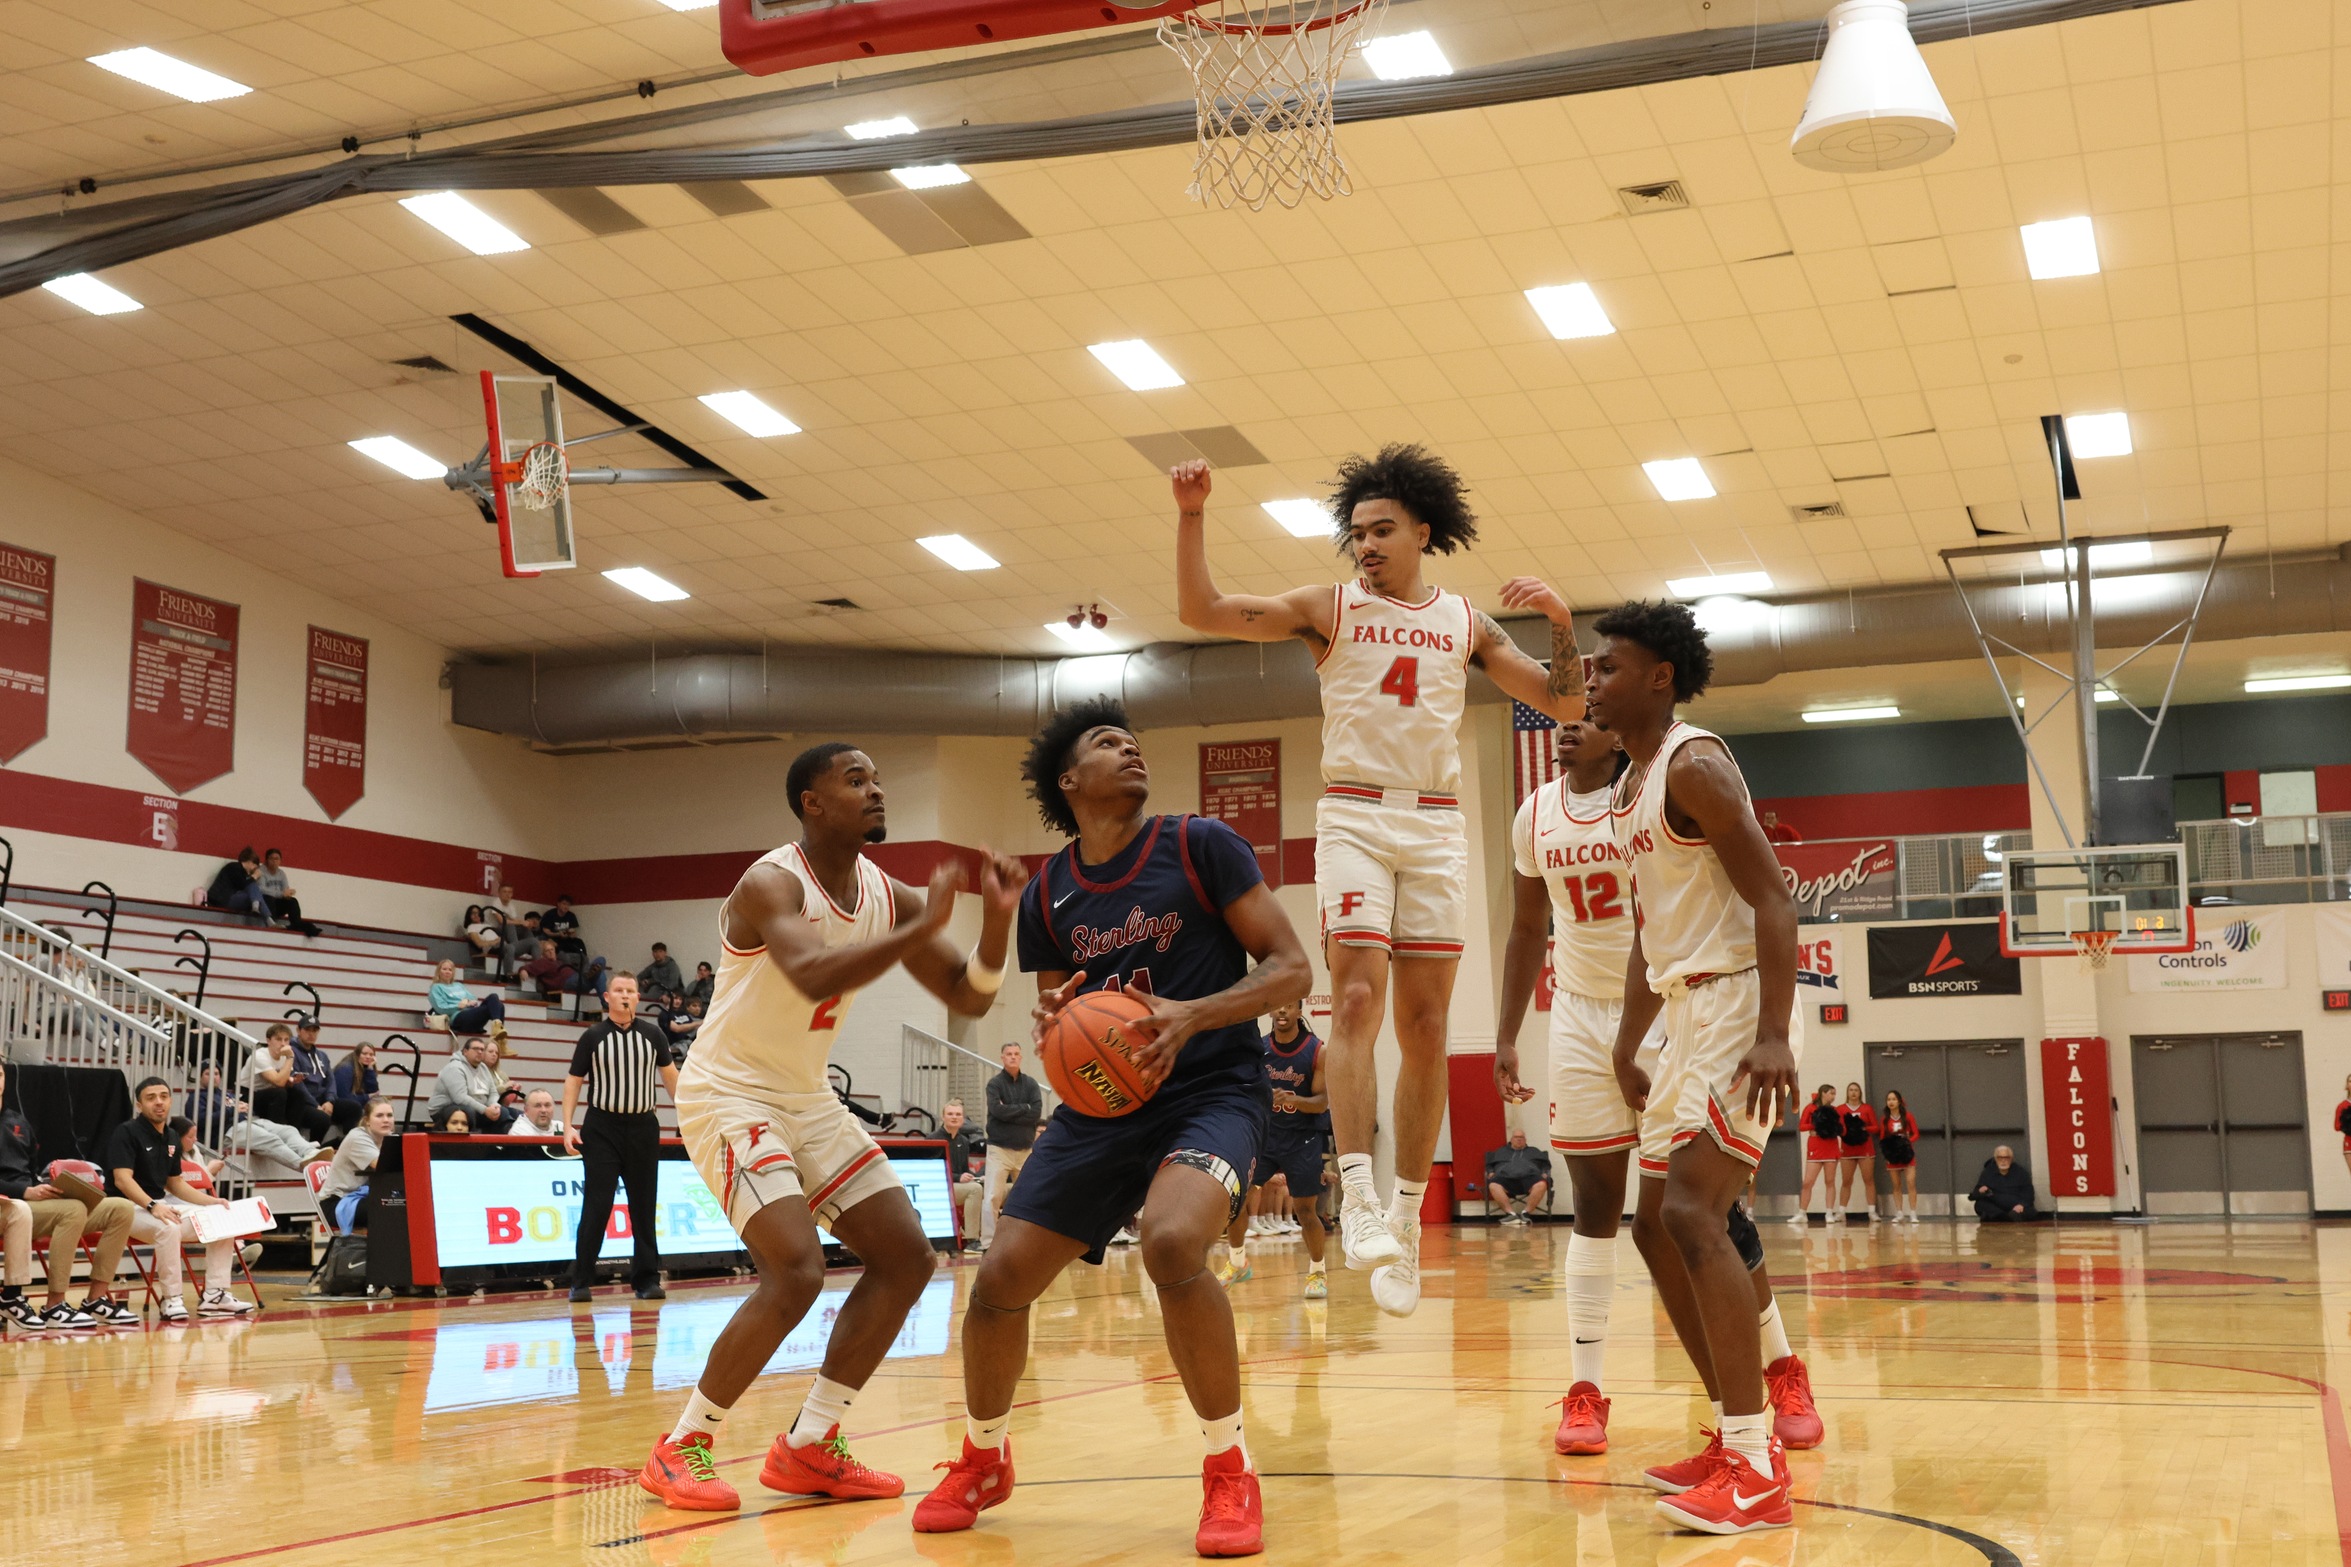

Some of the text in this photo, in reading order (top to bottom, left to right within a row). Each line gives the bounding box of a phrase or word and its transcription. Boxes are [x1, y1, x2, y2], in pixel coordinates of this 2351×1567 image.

[159, 590, 216, 619] FRIENDS
[158, 608, 215, 630] UNIVERSITY
[314, 631, 362, 657] FRIENDS
[1353, 625, 1454, 652] FALCONS
[1380, 655, 1420, 708] 4
[1206, 759, 1271, 770] UNIVERSITY
[1207, 745, 1272, 761] FRIENDS
[1232, 785, 1263, 793] CHAMPIONS
[143, 795, 178, 810] SECTION
[152, 811, 168, 842] E
[477, 851, 502, 863] SECTION
[1872, 857, 1894, 871] inc.
[484, 865, 496, 889] F
[1337, 891, 1366, 918] F
[1563, 871, 1626, 923] 12
[1830, 903, 1893, 913] promodepot.com
[1072, 905, 1182, 964] Sterling
[2159, 953, 2227, 968] Controls
[2160, 977, 2263, 987] INGENUITY WELCOME
[2328, 992, 2349, 1008] EXIT
[1825, 1007, 1844, 1021] EXIT
[1073, 1059, 1131, 1113] NAIA
[2067, 1043, 2089, 1193] FALCONS
[749, 1121, 770, 1149] F
